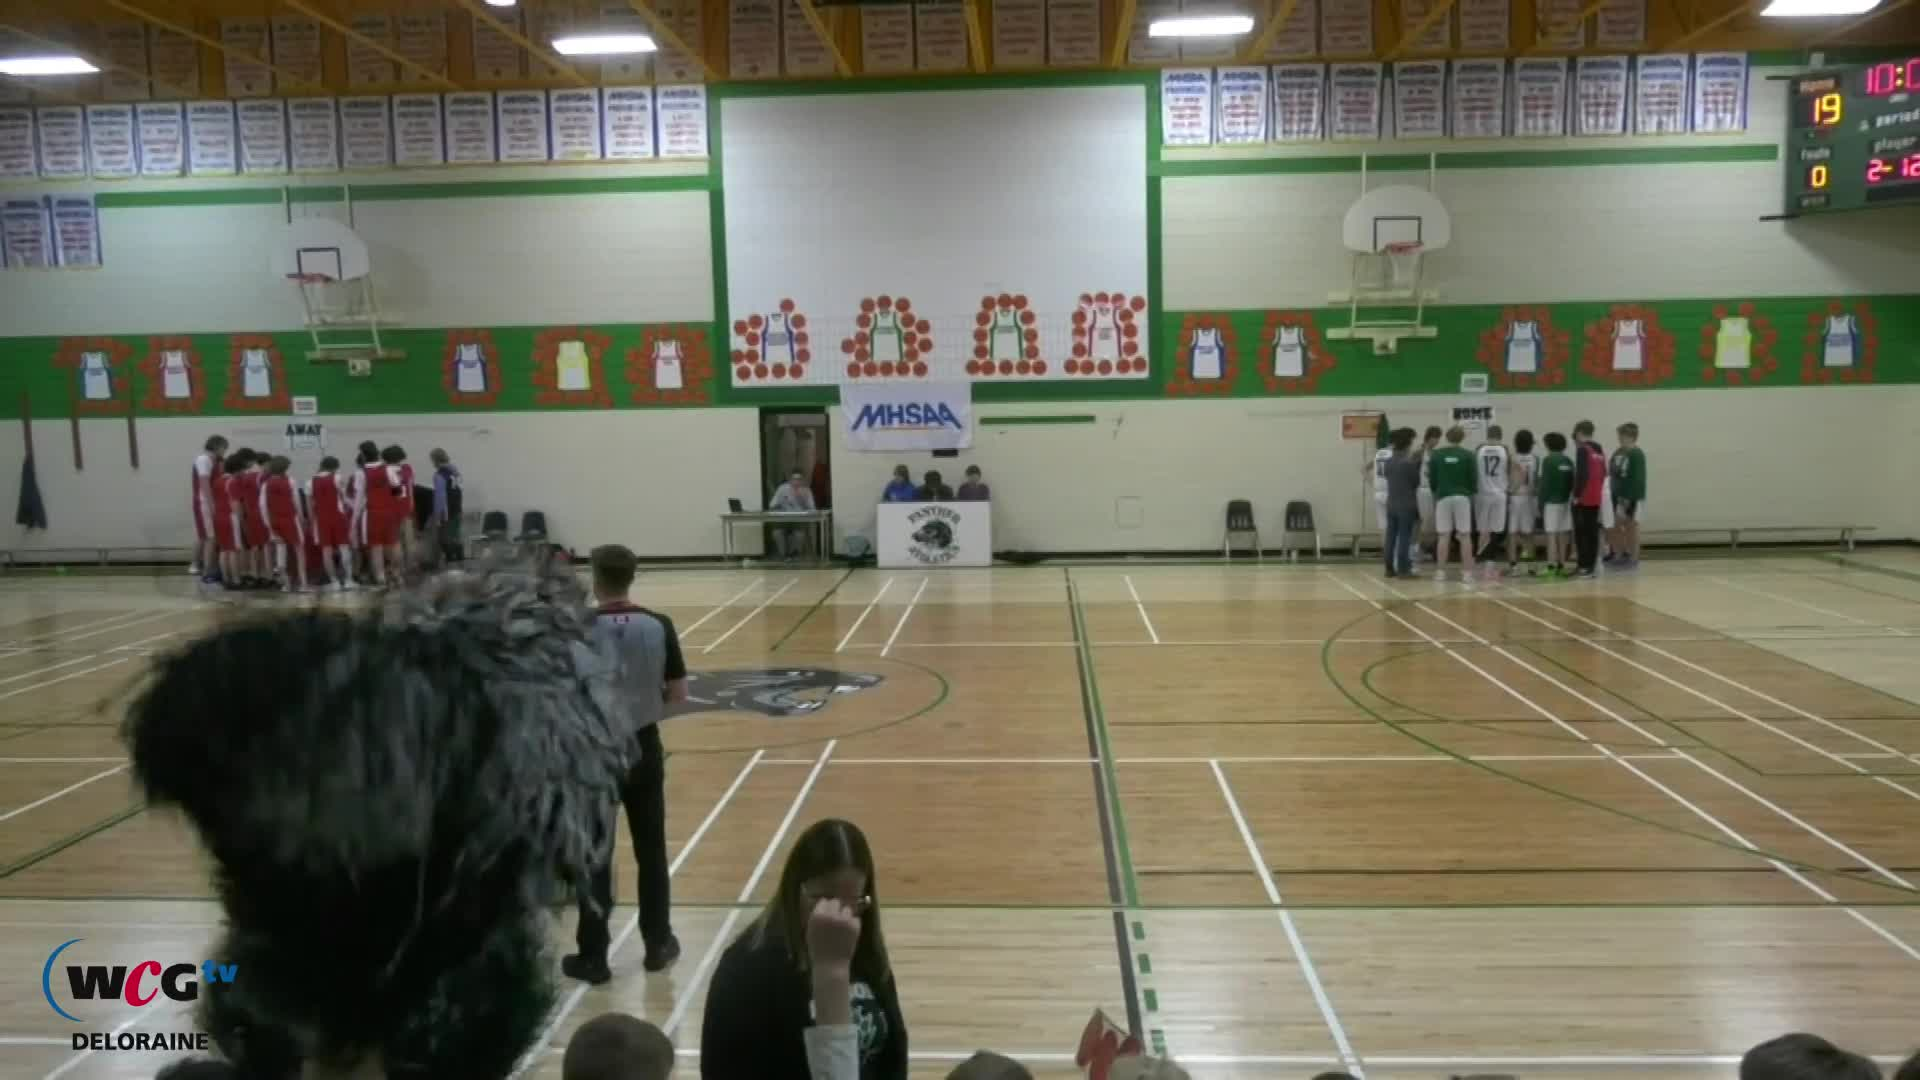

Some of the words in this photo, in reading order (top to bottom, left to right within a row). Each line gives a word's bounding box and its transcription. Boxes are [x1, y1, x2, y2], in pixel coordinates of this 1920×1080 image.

[1814, 94, 1841, 125] 19
[1811, 165, 1827, 189] 0
[852, 402, 962, 429] MHSAA
[285, 423, 322, 436] AWAY
[1484, 455, 1501, 477] 12
